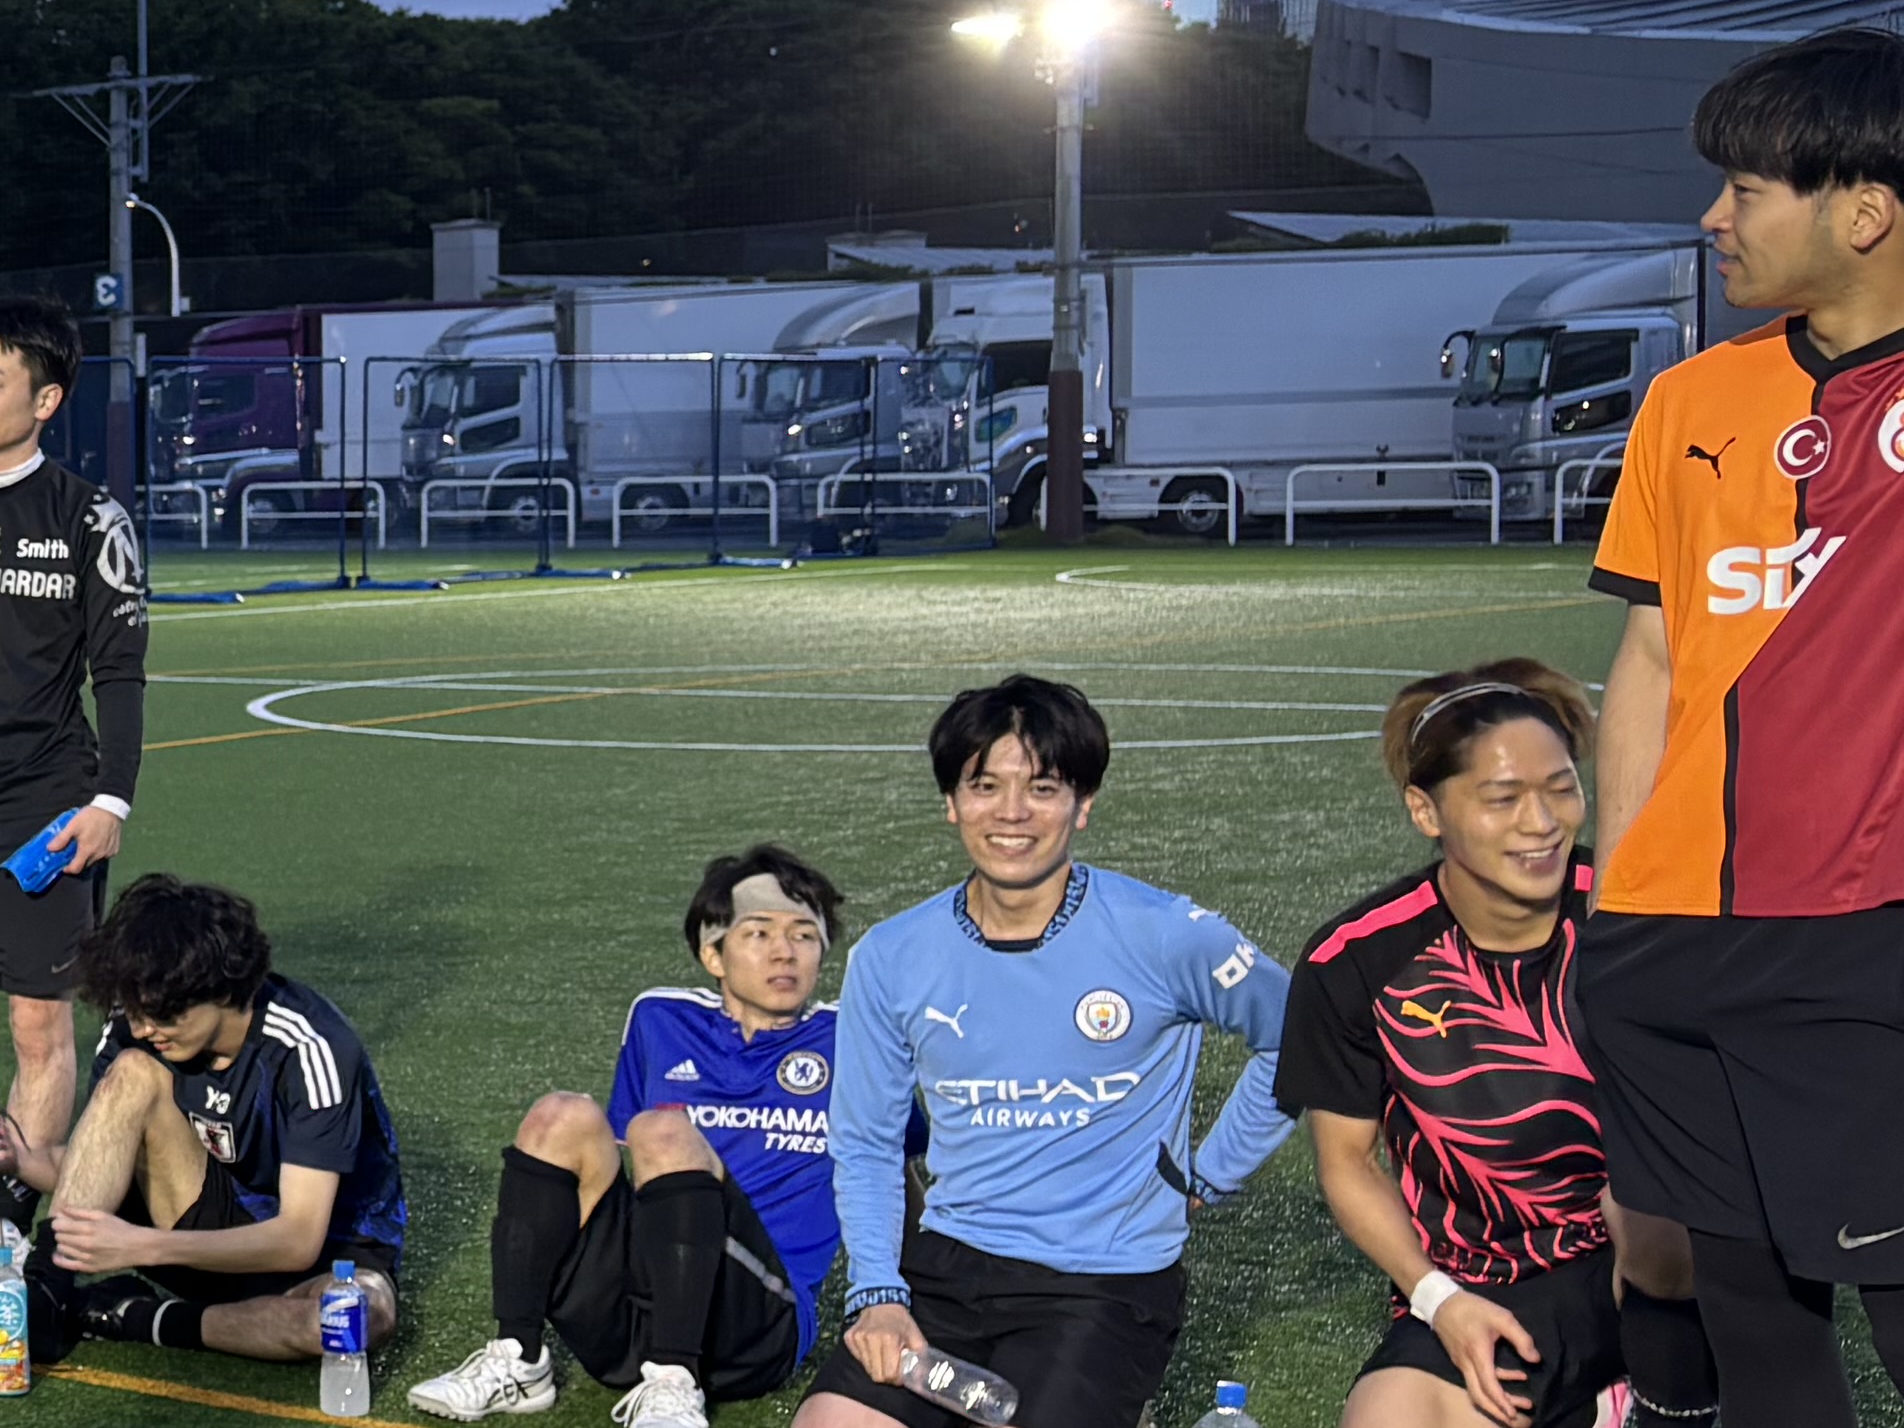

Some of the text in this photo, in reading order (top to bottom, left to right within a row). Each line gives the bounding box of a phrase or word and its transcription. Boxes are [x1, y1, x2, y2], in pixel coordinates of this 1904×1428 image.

[16, 538, 69, 560] Smith
[935, 1072, 1142, 1106] ETIHAD
[686, 1104, 829, 1133] YOKOHAMA
[970, 1107, 1091, 1128] AIRWAYS
[764, 1132, 827, 1154] TYRES
